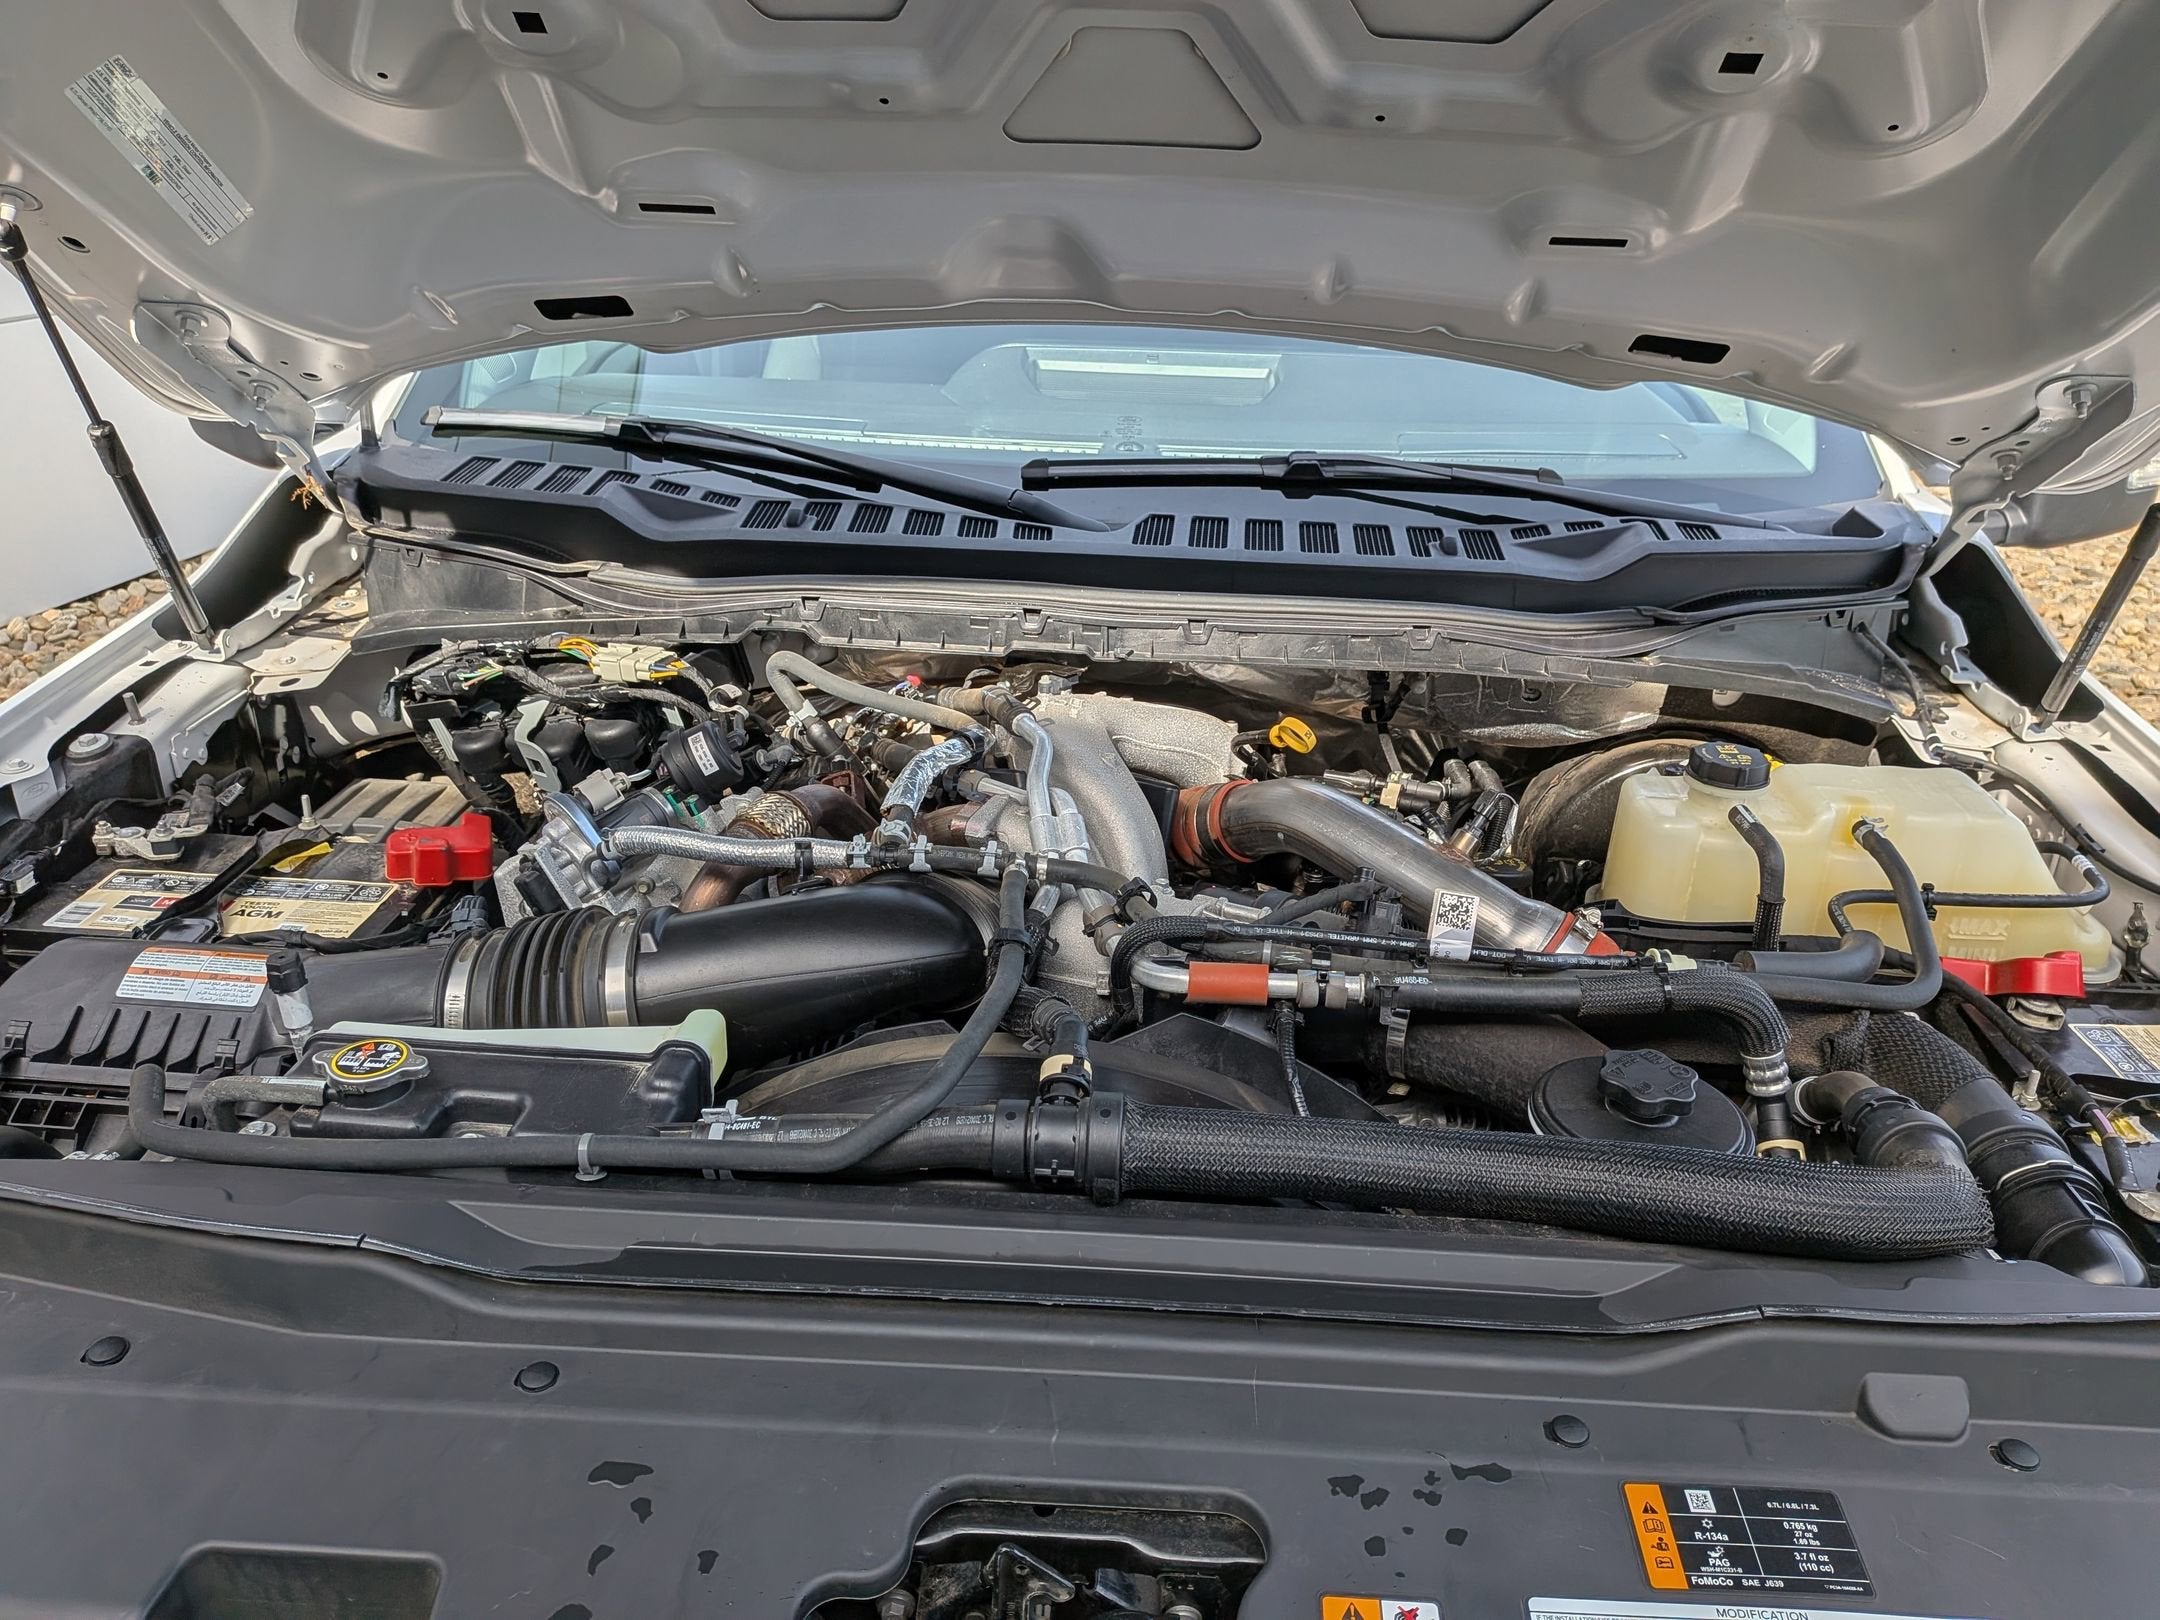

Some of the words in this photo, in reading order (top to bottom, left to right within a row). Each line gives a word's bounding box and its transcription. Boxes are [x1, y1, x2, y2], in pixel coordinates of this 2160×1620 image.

[230, 909, 284, 918] AGM
[1783, 1522, 1806, 1530] 0.765
[1806, 1523, 1818, 1532] kg
[1694, 1532, 1729, 1541] R-134a
[1794, 1552, 1807, 1560] 3.7
[1809, 1552, 1816, 1561] fl
[1708, 1558, 1730, 1567] PAG
[1799, 1562, 1818, 1572] (110
[1820, 1564, 1834, 1574] cc)
[1691, 1576, 1734, 1586] FoMoCo
[1742, 1578, 1761, 1586] SAE
[1764, 1580, 1784, 1588] J639
[1716, 1608, 1809, 1620] MODIFICATION
